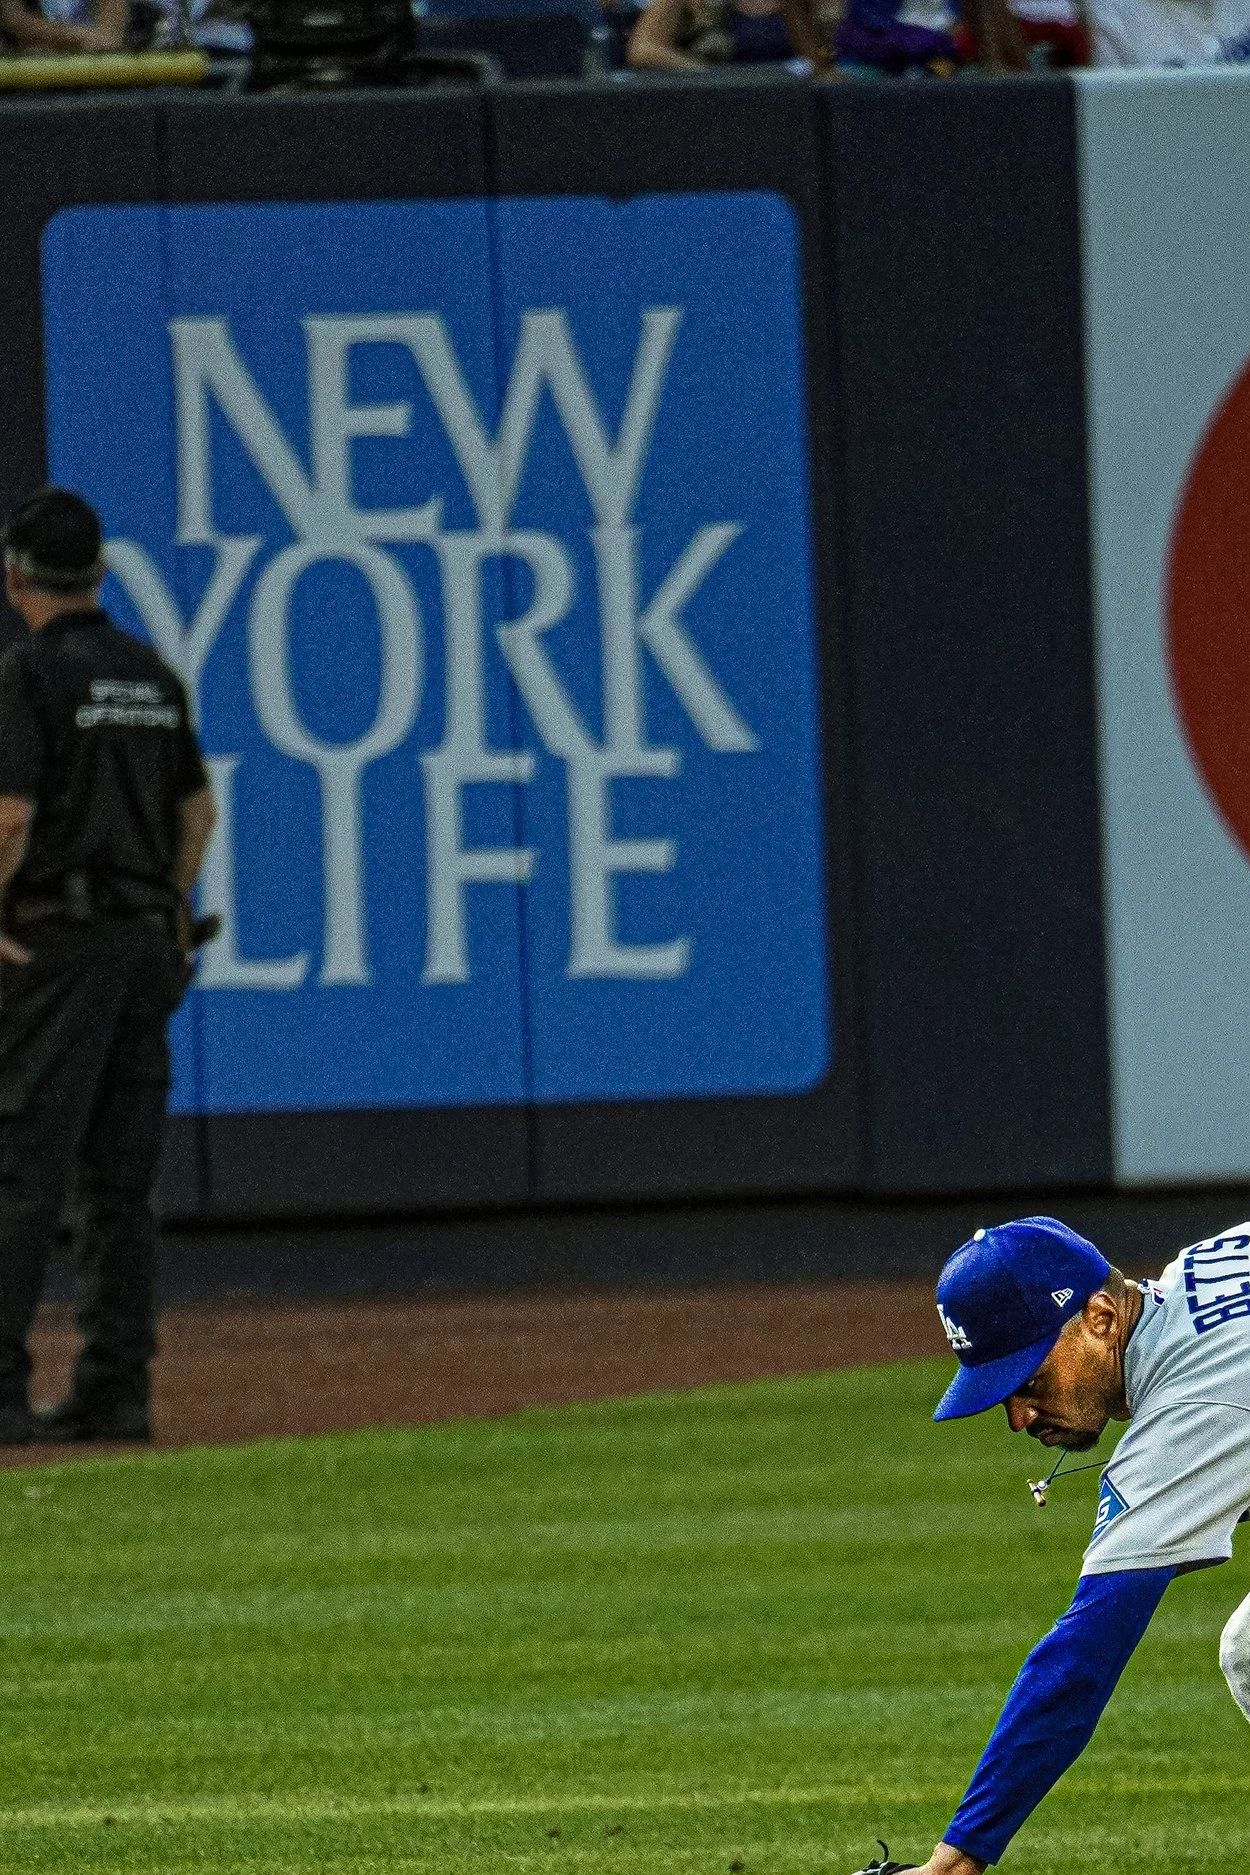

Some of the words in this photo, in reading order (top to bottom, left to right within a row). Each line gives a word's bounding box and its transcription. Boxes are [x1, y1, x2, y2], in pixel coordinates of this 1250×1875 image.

[170, 308, 683, 546] NEW
[103, 522, 762, 756] YORK
[188, 748, 693, 990] LIFE
